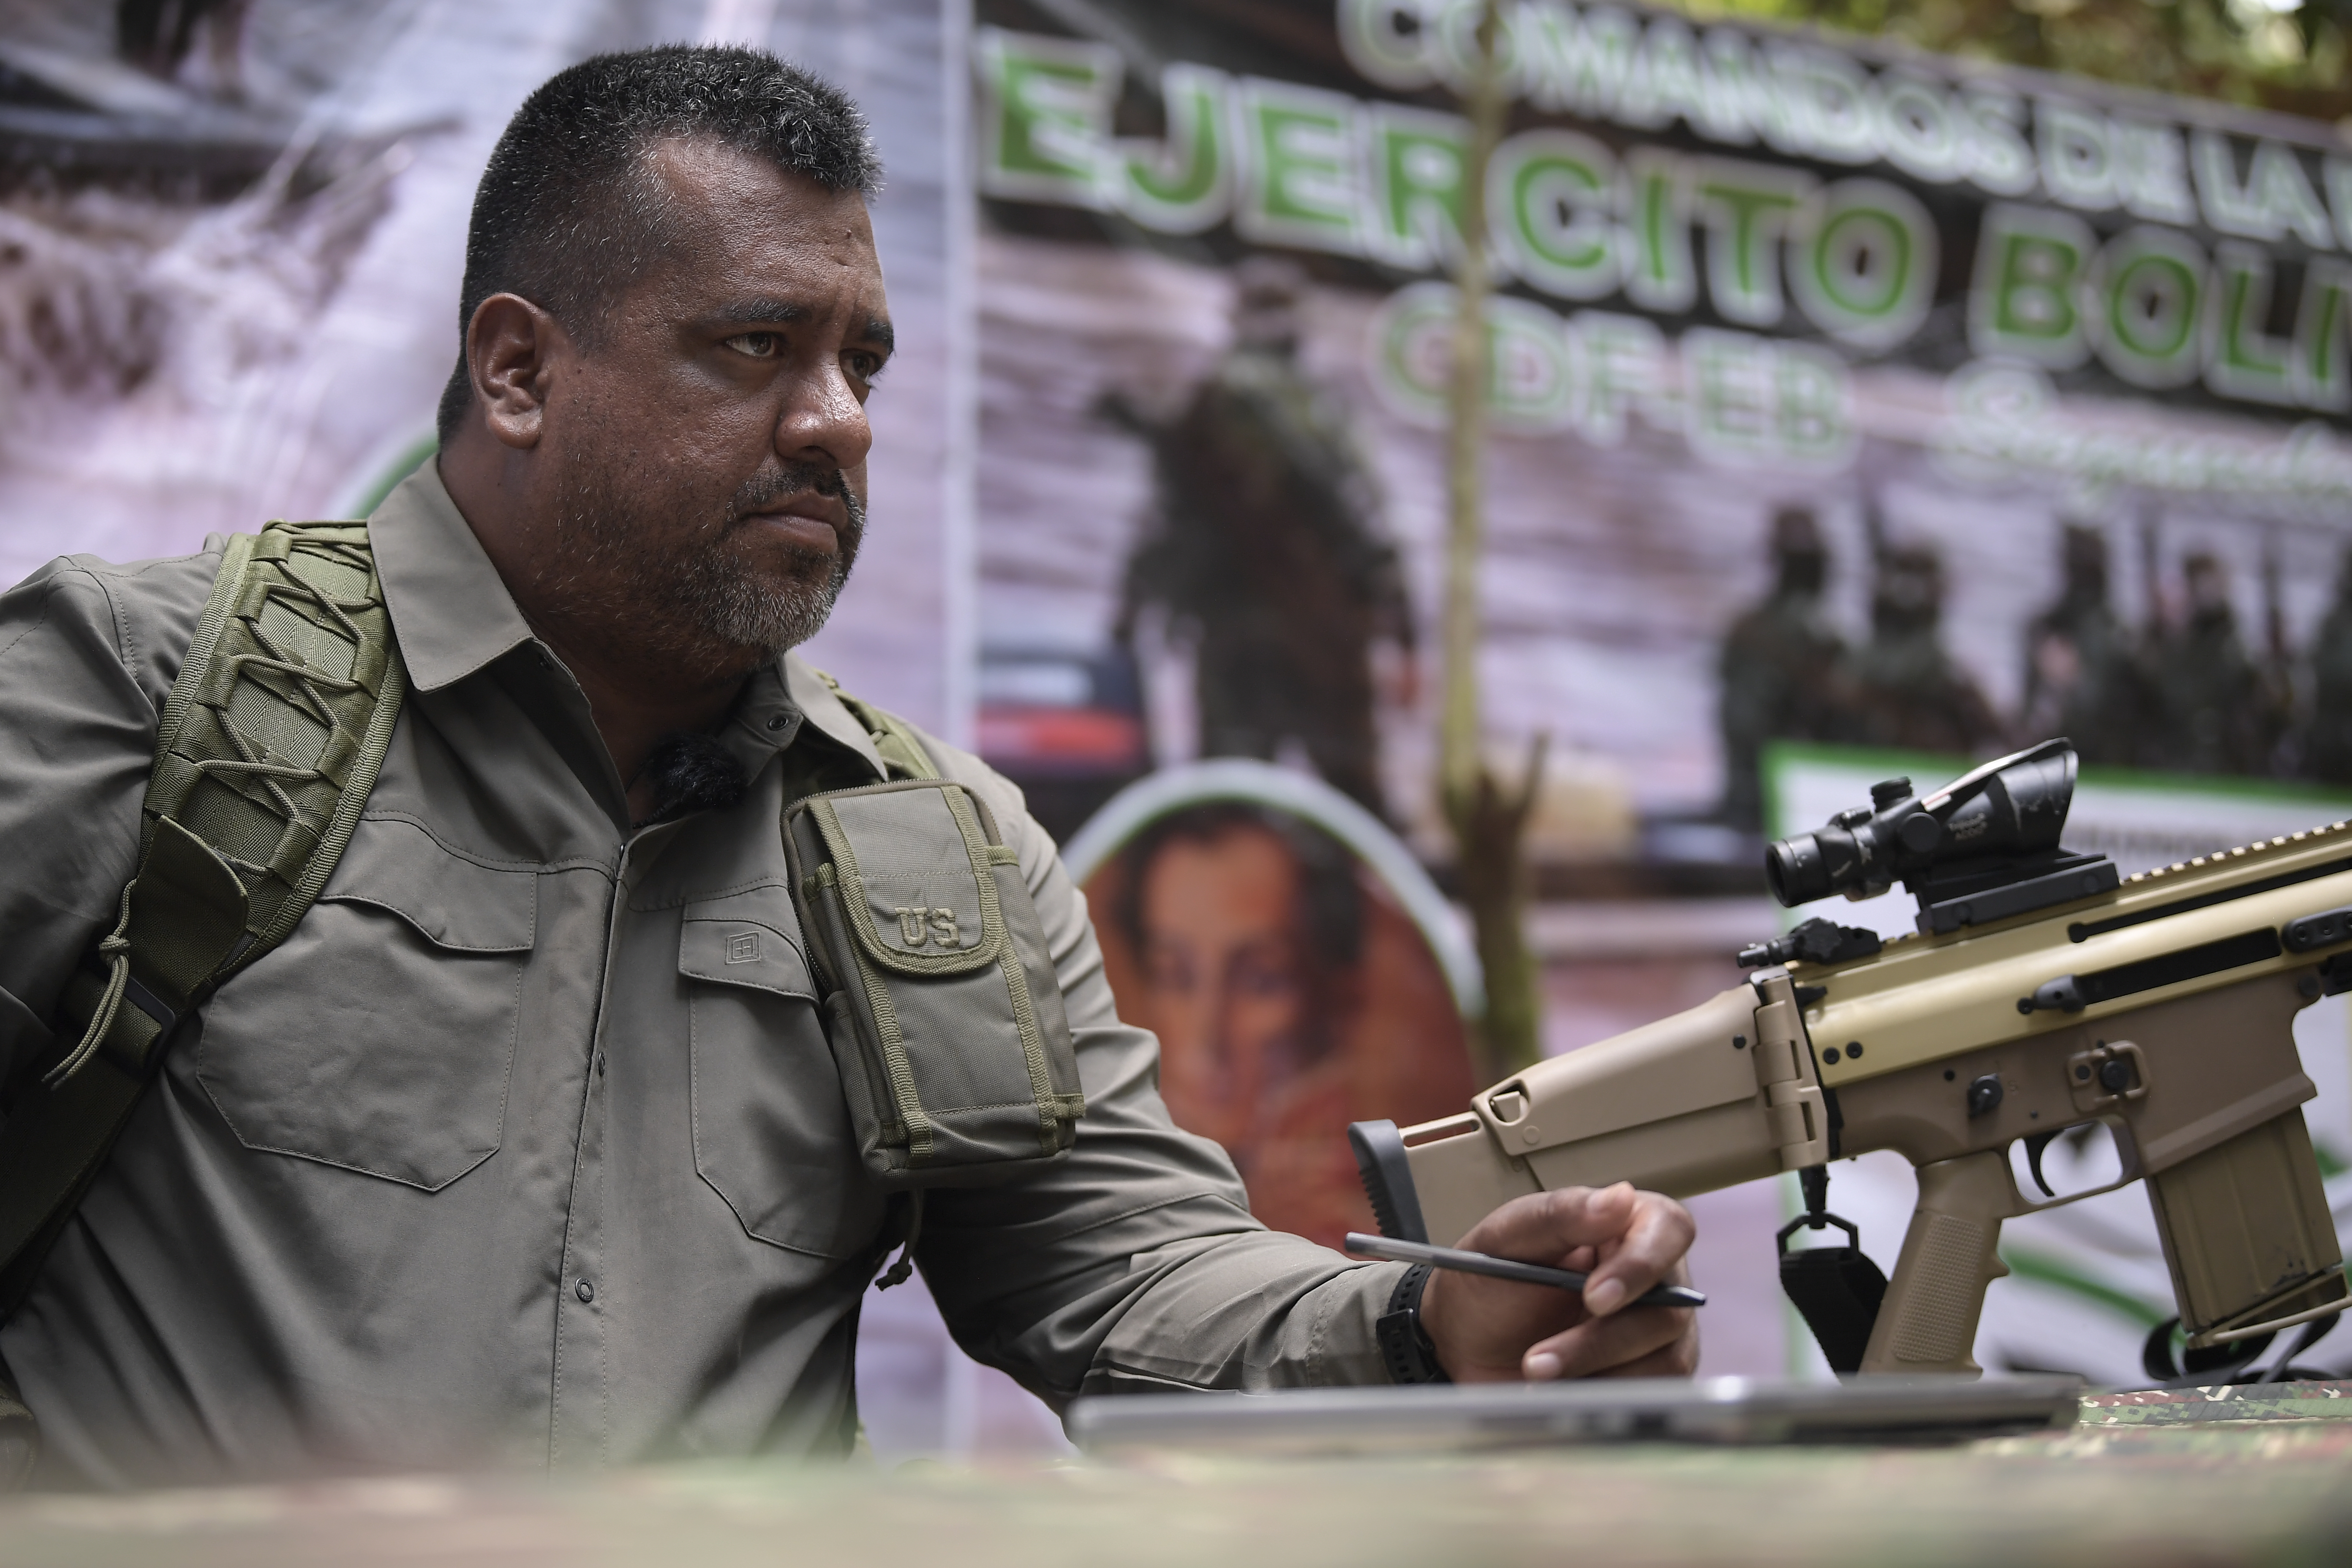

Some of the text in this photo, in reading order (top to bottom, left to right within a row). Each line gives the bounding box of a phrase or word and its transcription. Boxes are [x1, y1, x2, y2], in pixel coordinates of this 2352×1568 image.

[980, 30, 1938, 350] EJERCITO
[1968, 203, 2349, 411] BOLI
[1341, 0, 2035, 193] COMANDOS
[2035, 99, 2196, 226] DE
[2191, 128, 2336, 250] LA
[895, 907, 959, 946] US
